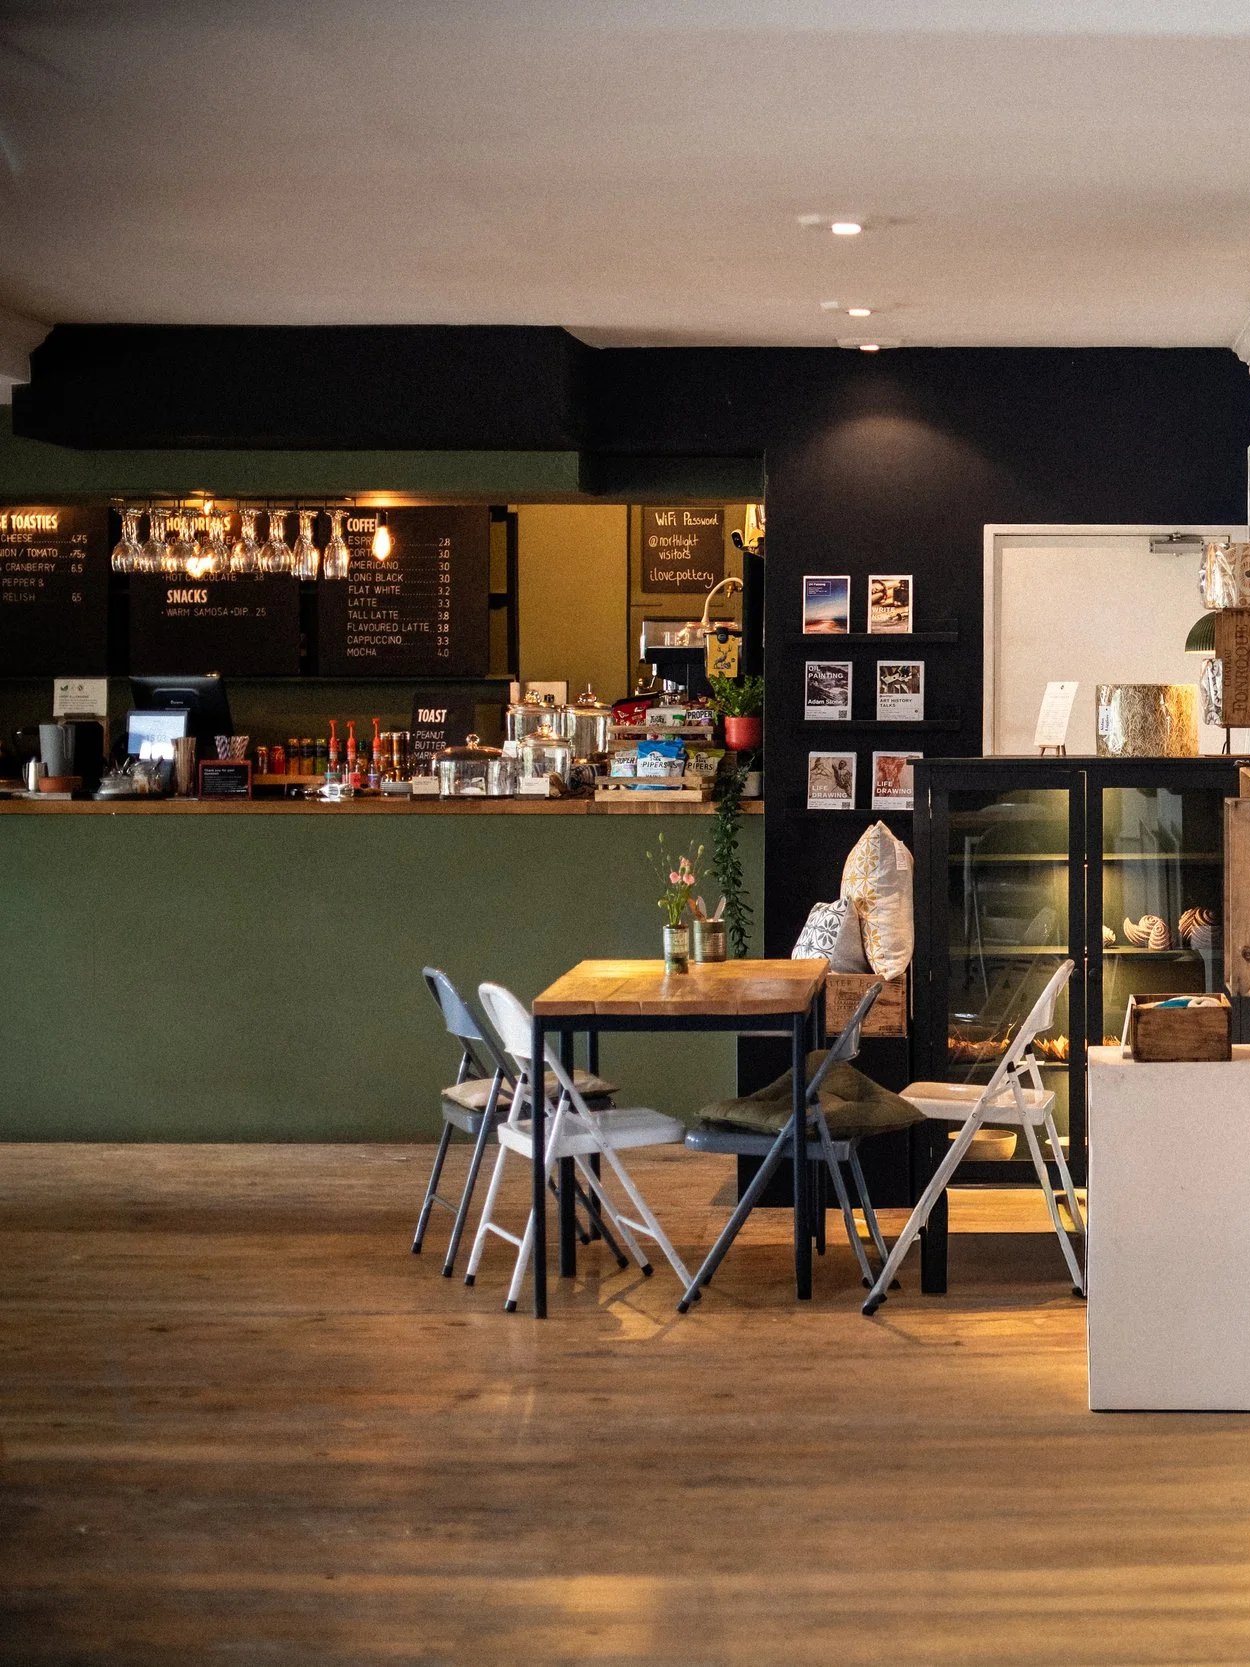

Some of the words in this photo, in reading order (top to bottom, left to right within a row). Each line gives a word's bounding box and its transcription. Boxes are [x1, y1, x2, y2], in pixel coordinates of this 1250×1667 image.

[10, 514, 58, 530] TOASTIES
[655, 512, 677, 526] WiFi
[684, 512, 718, 526] Password
[1, 534, 33, 543] CHEESE
[26, 548, 59, 558] TOMATO
[658, 548, 692, 560] visitors
[5, 562, 56, 573] CRANBERRY
[349, 561, 399, 570] AMERICANO
[348, 574, 372, 582] LONG
[375, 574, 404, 583] BLACK
[348, 586, 370, 595] FLAT
[374, 586, 400, 595] WHITE
[166, 589, 208, 604] SNACKS
[348, 598, 378, 608] LATTE
[166, 608, 190, 617] WARM
[194, 608, 228, 616] SAMOSA
[348, 610, 368, 620] TALL
[371, 610, 399, 620] LATTE
[347, 623, 398, 632] FLAVOURED
[402, 623, 430, 632] LATTE
[347, 636, 402, 645] CAPPUCCINO
[346, 648, 377, 657] MOCHA
[418, 709, 448, 722] TOAST
[688, 710, 712, 720] PROPER
[416, 730, 445, 740] PEANUT
[414, 741, 447, 750] BUTTER
